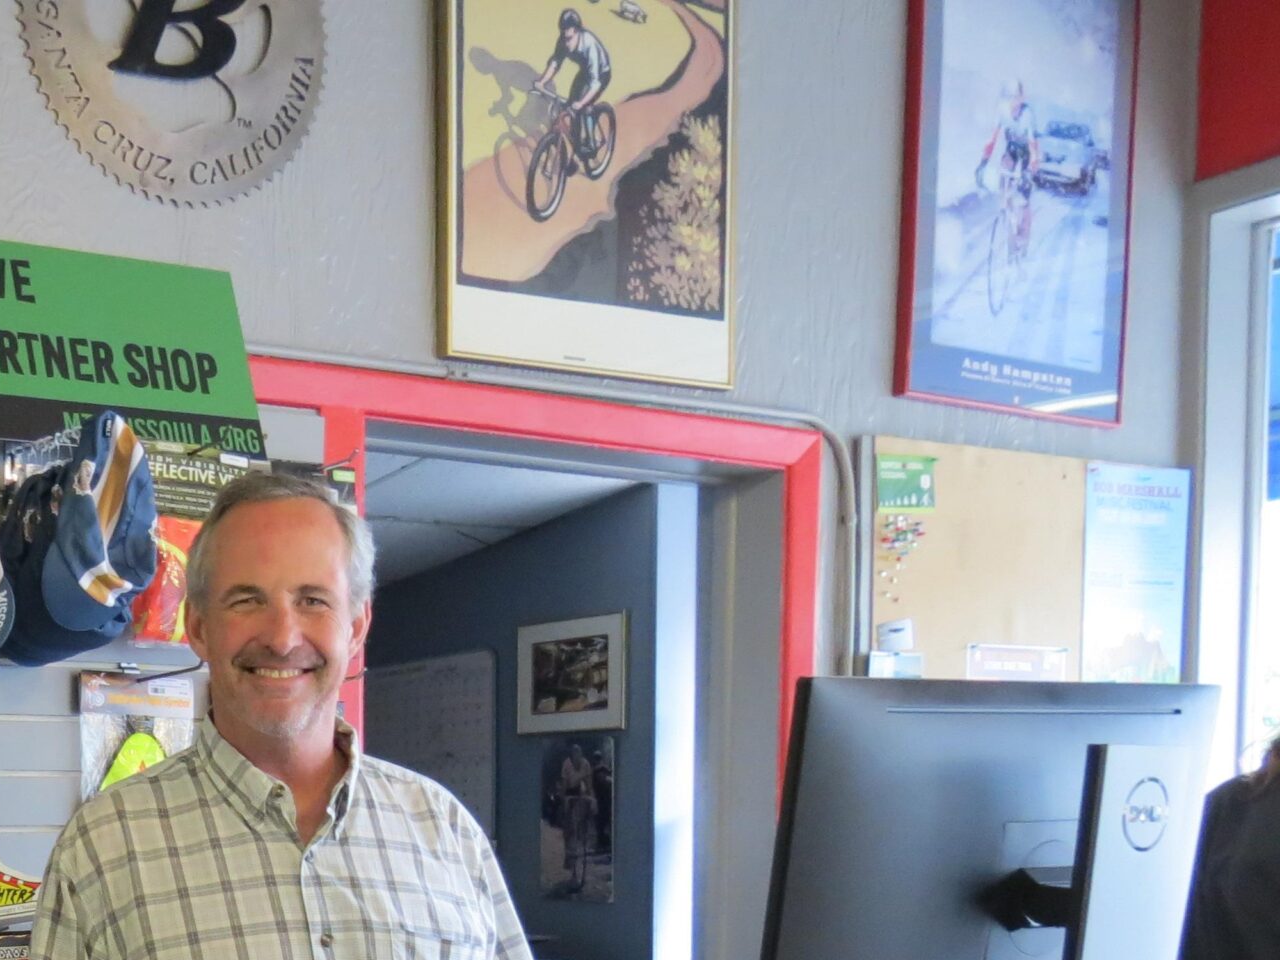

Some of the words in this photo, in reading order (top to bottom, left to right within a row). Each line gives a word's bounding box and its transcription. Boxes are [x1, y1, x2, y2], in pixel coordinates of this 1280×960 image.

[93, 119, 176, 186] CRUZ,
[189, 56, 315, 186] CALIFORNIA
[122, 343, 218, 395] SHOP
[148, 461, 216, 485] EFLECTIVE
